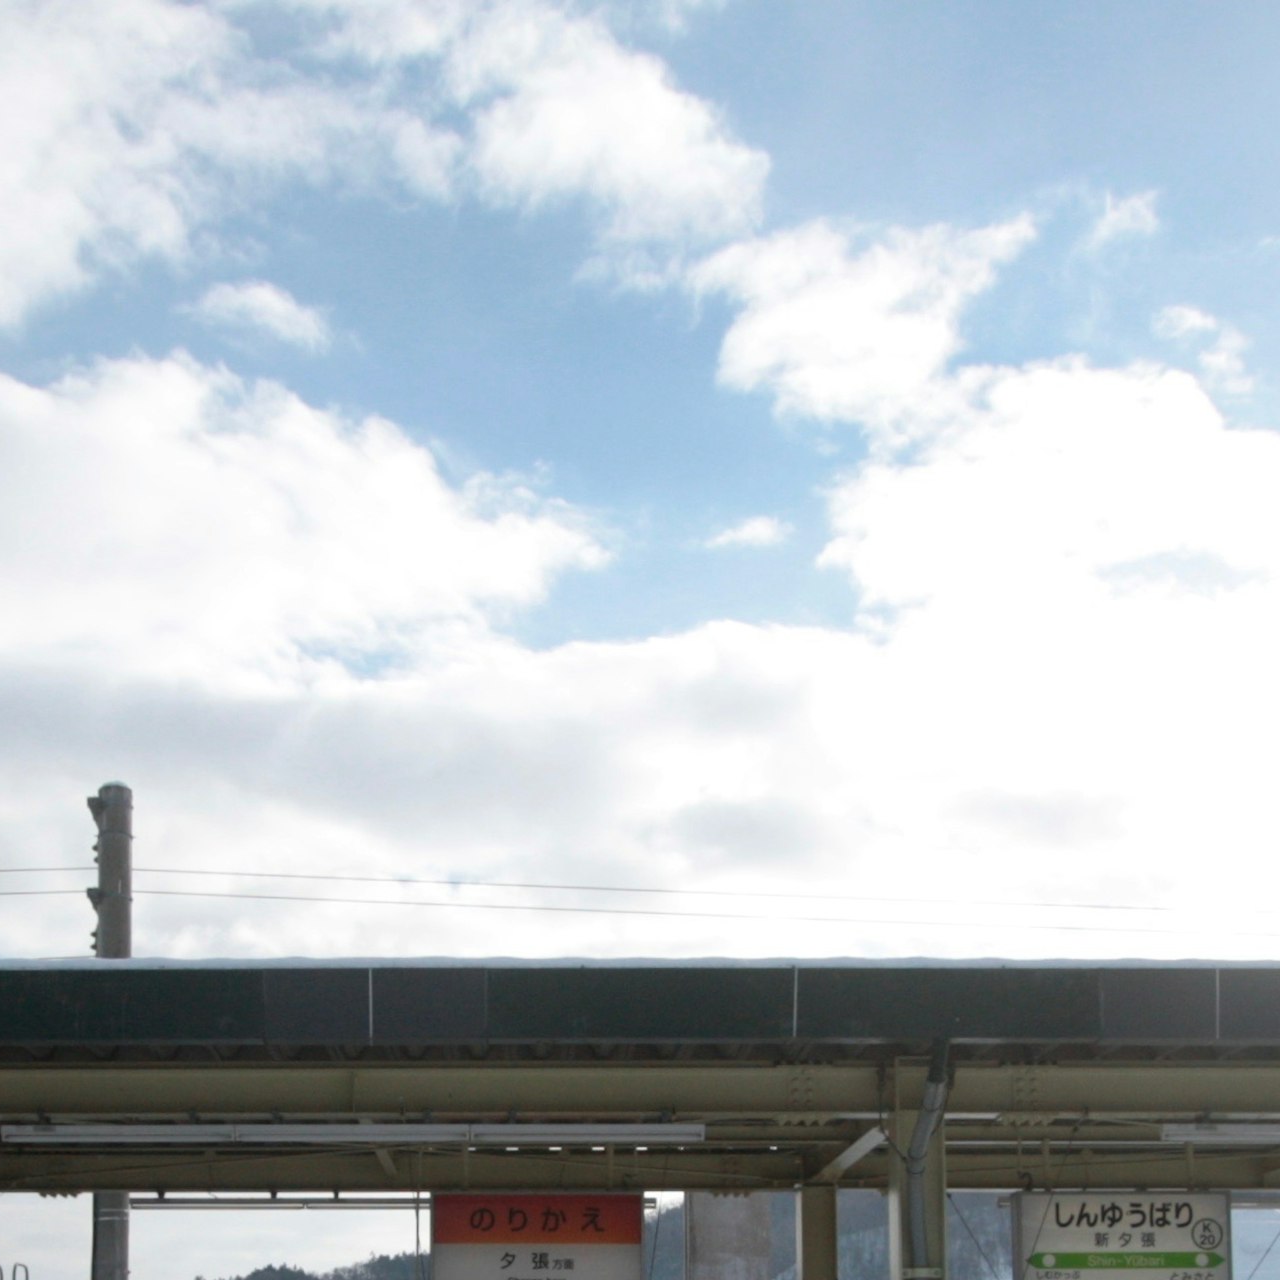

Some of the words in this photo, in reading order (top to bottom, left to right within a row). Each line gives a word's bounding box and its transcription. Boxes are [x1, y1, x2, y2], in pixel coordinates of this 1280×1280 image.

[470, 1207, 605, 1232] のりかえ
[1055, 1202, 1193, 1228] しんゆうばり
[1202, 1223, 1211, 1233] K
[1094, 1232, 1156, 1248] 新夕張
[1199, 1235, 1215, 1246] 20
